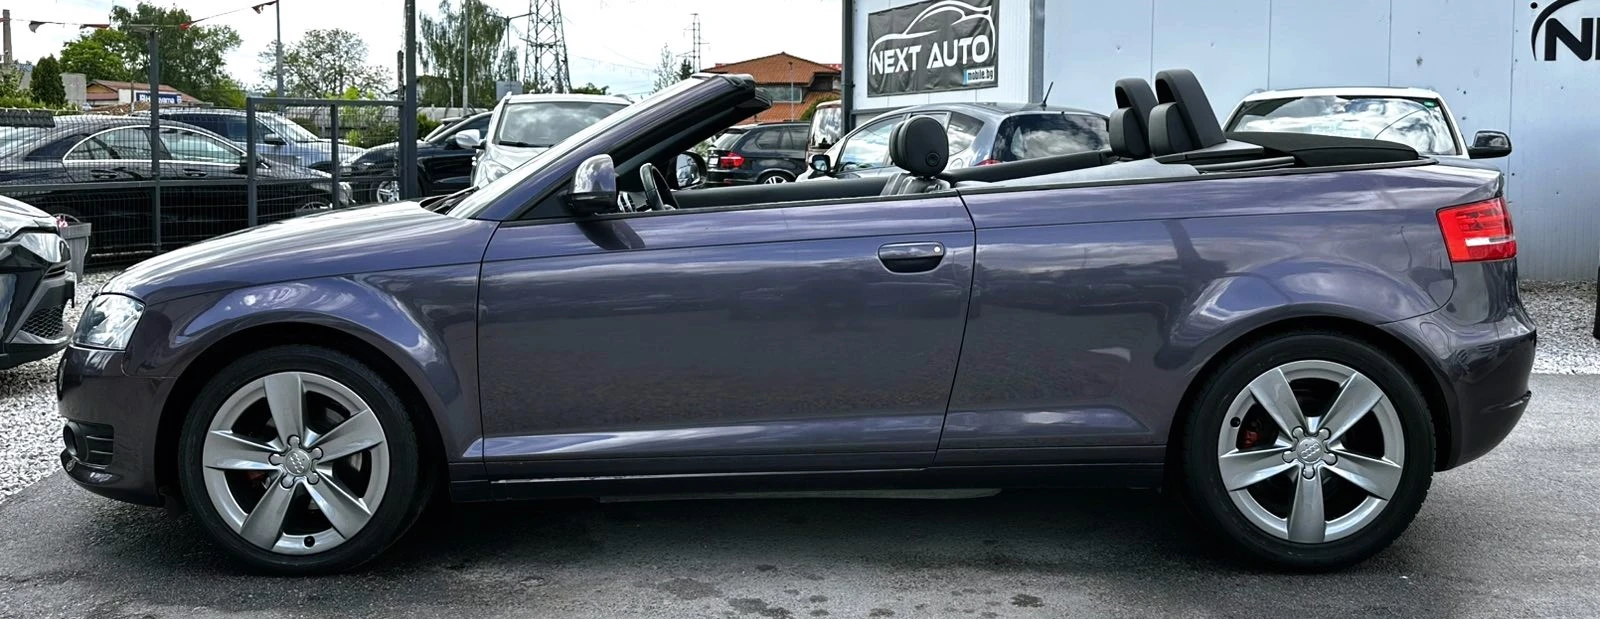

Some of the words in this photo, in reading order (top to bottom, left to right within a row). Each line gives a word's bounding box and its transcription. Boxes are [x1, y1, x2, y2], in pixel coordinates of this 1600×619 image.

[872, 45, 922, 75] NEXT
[927, 35, 990, 69] AUTO
[967, 69, 994, 80] mobile.bg
